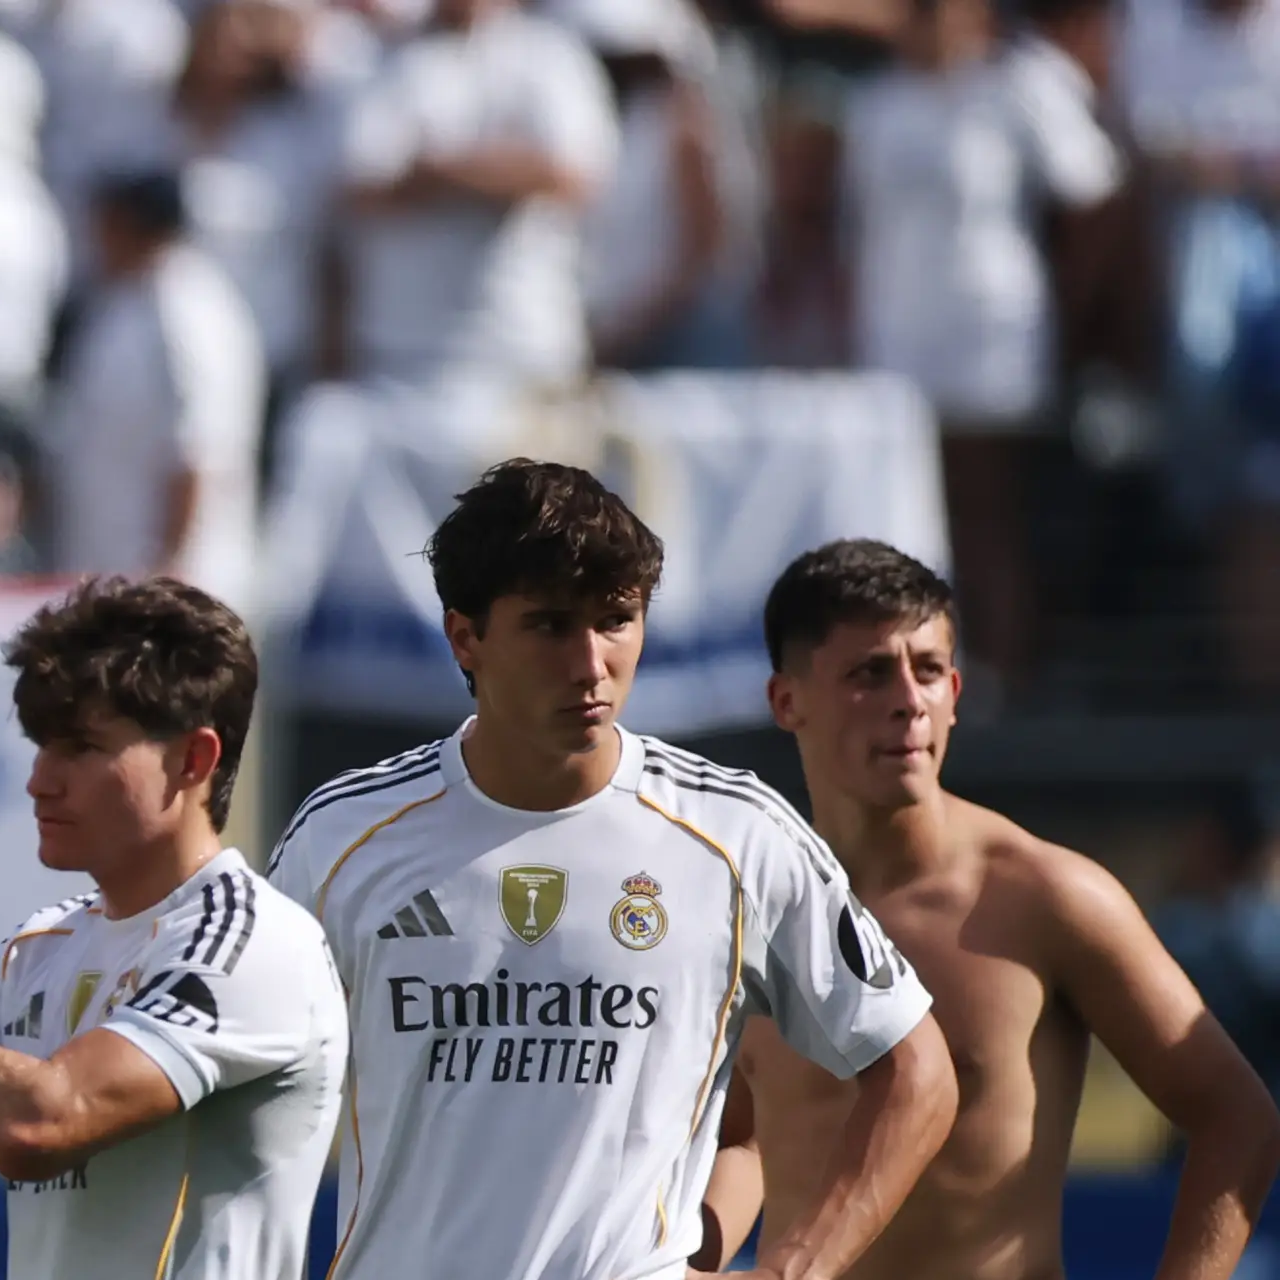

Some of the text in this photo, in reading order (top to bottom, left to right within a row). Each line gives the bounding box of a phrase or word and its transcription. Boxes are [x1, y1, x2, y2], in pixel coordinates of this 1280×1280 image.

[387, 968, 659, 1032] Emirates
[427, 1038, 619, 1085] FLY BETTER
